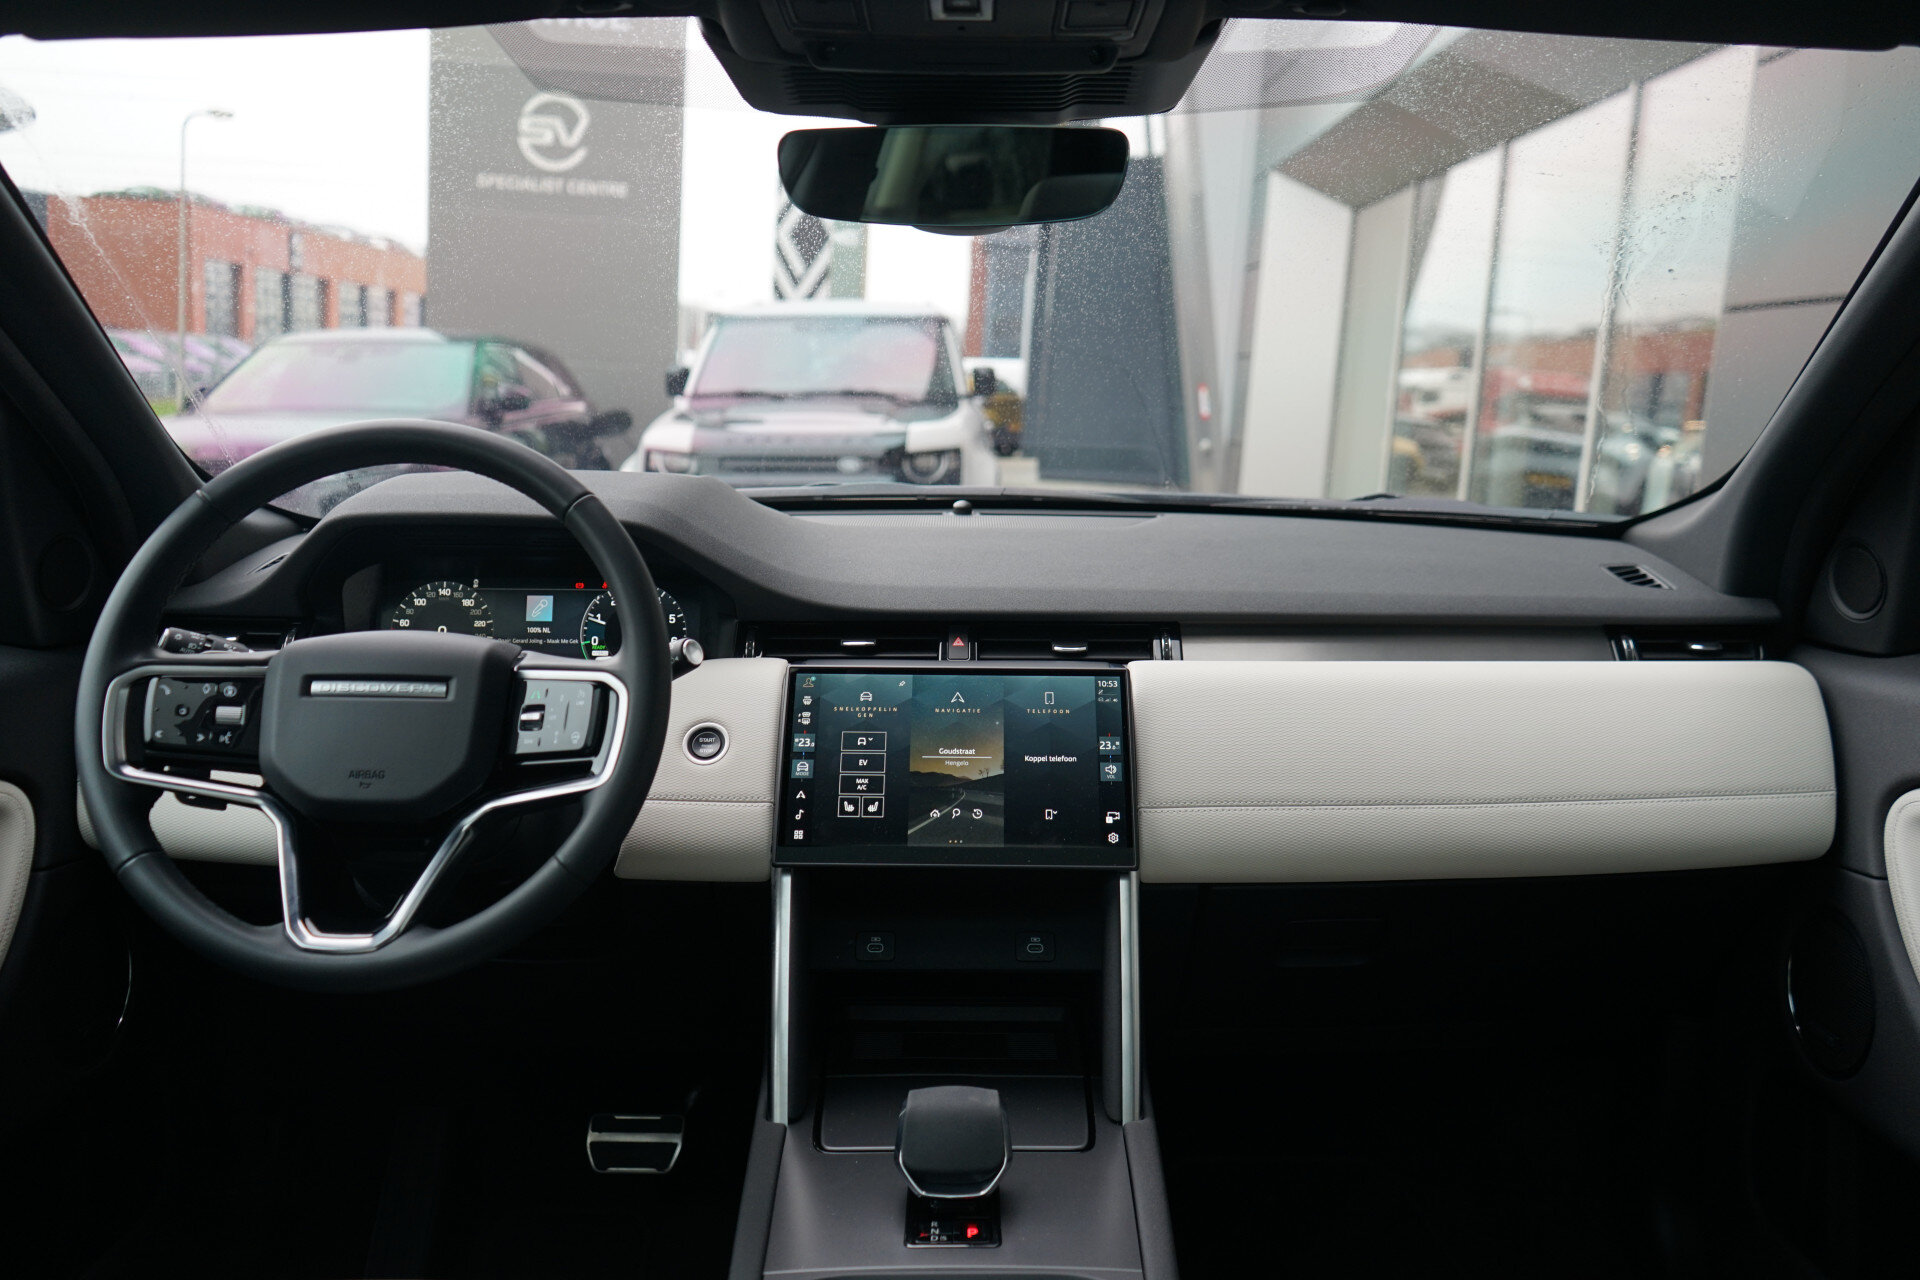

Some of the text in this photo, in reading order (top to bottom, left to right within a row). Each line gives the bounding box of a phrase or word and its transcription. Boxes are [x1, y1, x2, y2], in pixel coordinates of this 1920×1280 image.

[476, 172, 630, 199] SPECIALIST CENTRE
[438, 588, 451, 596] 140
[413, 598, 426, 606] 100
[462, 599, 475, 607] 180
[596, 613, 602, 622] 1
[668, 613, 677, 624] 5
[399, 619, 410, 627] 60
[473, 620, 486, 628] 220
[527, 626, 541, 634] 100%
[591, 635, 599, 646] 0
[320, 682, 438, 693] DISCOVERY
[1098, 680, 1118, 688] 10:53
[938, 747, 976, 755] Goudstraat
[944, 759, 969, 767] Hengelo
[1024, 755, 1077, 763] Koppel telefoon
[348, 769, 386, 779] AIRBAG
[966, 1226, 979, 1239] P
